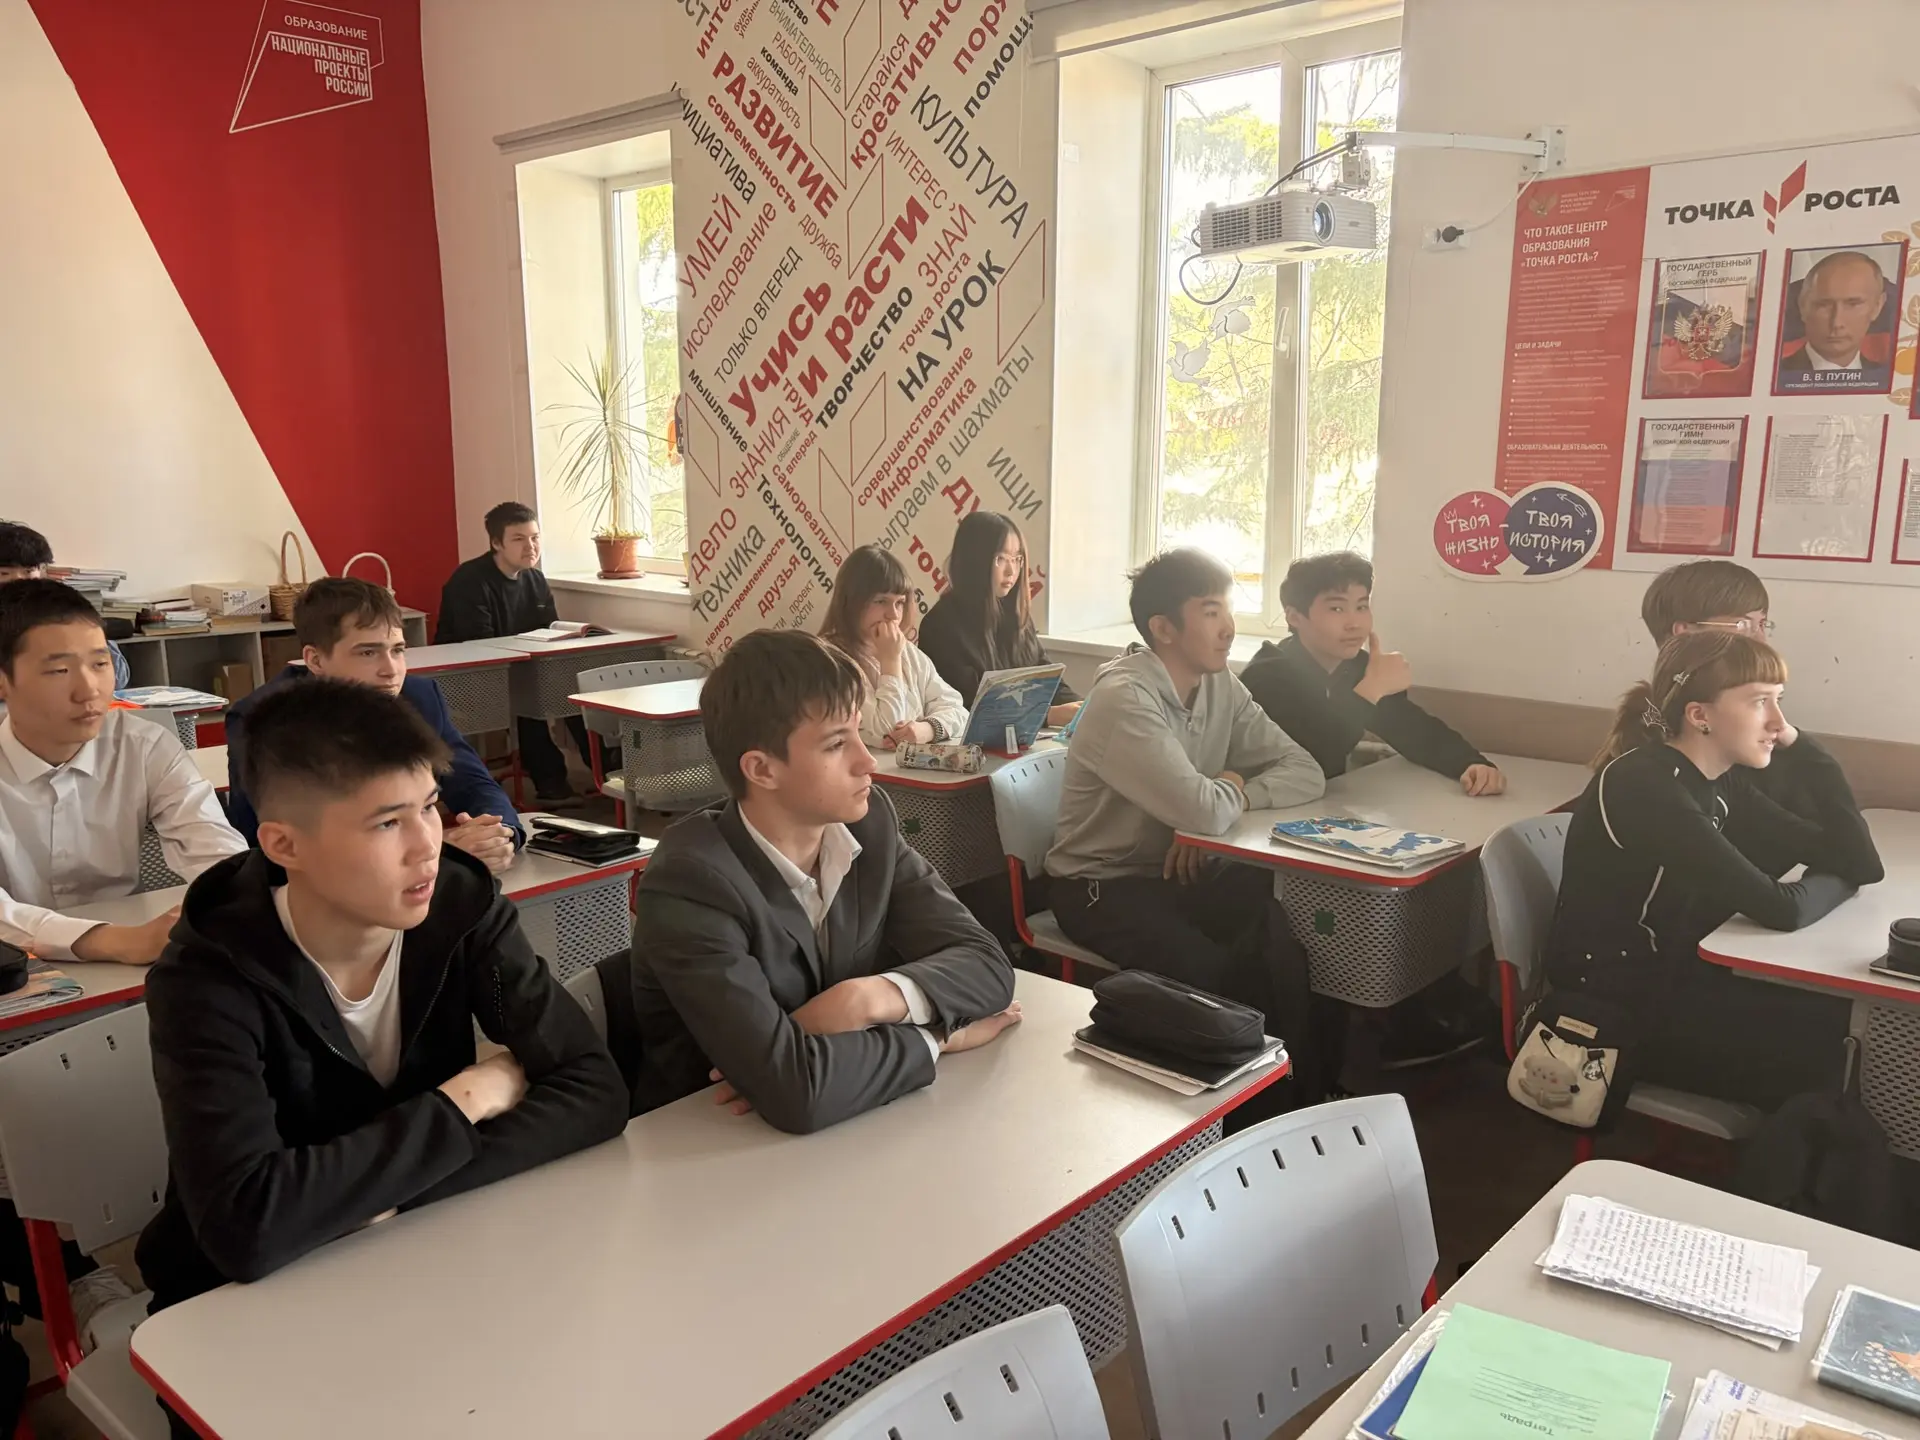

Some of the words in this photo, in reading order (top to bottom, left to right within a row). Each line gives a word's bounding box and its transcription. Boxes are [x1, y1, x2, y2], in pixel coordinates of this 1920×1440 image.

[271, 35, 367, 66] НАЦИОНАЛЬНЫЕ
[284, 15, 368, 40] ОБРАЗОВАНИЕ
[733, 7, 749, 32] будь
[769, 1, 842, 94] ВНИМАТЕЛЬНОСТЬ
[772, 31, 808, 80] РАБОТА
[314, 58, 368, 82] ПРОЕКТЫ
[325, 76, 369, 97] РОССИИ
[746, 56, 801, 129] аккуратность
[760, 46, 799, 97] команда
[850, 33, 910, 129] старайся
[963, 11, 1034, 119] помощ
[707, 95, 796, 214] современность
[712, 51, 839, 219] РАЗВИТИЕ
[885, 130, 948, 209] ИНТЕРЕС
[910, 84, 1029, 239] КУЛЬТУРА
[1524, 227, 1542, 239] ЧТО
[1544, 223, 1574, 237] ТАКОЕ
[1576, 220, 1608, 234] ЦЕНТР
[1664, 199, 1755, 225] ТОЧКА
[1804, 184, 1901, 212] РОСТА
[679, 192, 741, 298] УМЕЙ
[798, 213, 843, 271] дружба
[918, 202, 977, 288] ЗНАЙ
[1522, 237, 1590, 254] ОБРАЗОВАНИЯ
[1666, 257, 1752, 273] ГОСУДАРСТВЕННЫЙ
[682, 202, 777, 360] исследование
[713, 317, 758, 384] ТОЛЬКО
[753, 246, 803, 321] ВПЕРЕД
[797, 354, 829, 399] и
[824, 194, 930, 364] расти
[899, 305, 935, 355] точка
[932, 252, 972, 309] роста
[727, 282, 832, 428] Учись
[815, 286, 913, 429] ТВОРЧЕСТВО
[897, 350, 941, 403] НА
[931, 248, 1006, 351] УРОК
[688, 369, 748, 453] мышление
[935, 453, 952, 476] в
[949, 344, 1035, 458] шахматы
[1803, 373, 1812, 381] В.
[1814, 373, 1824, 381] В.
[1826, 372, 1861, 381] ПУТИН
[729, 406, 791, 499] ЗНАНИЯ
[785, 430, 818, 476] вперед
[857, 346, 973, 507] совершенствование
[876, 377, 978, 510] Информатика
[1651, 421, 1735, 432] ГОСУДАРСТВЕННЫЙ
[986, 446, 1044, 520] ИЩИ
[1526, 510, 1573, 529] ТВОЯ
[756, 474, 834, 594] Технология
[1445, 535, 1500, 557] ЖИЗНЬ
[1446, 513, 1491, 534] ТВОЯ
[1509, 531, 1586, 554] ИСТОРИЯ
[705, 537, 786, 647] целеустремленность
[757, 554, 801, 619] друзья
[789, 579, 816, 614] проект
[1499, 1411, 1555, 1437] Тетрадь
